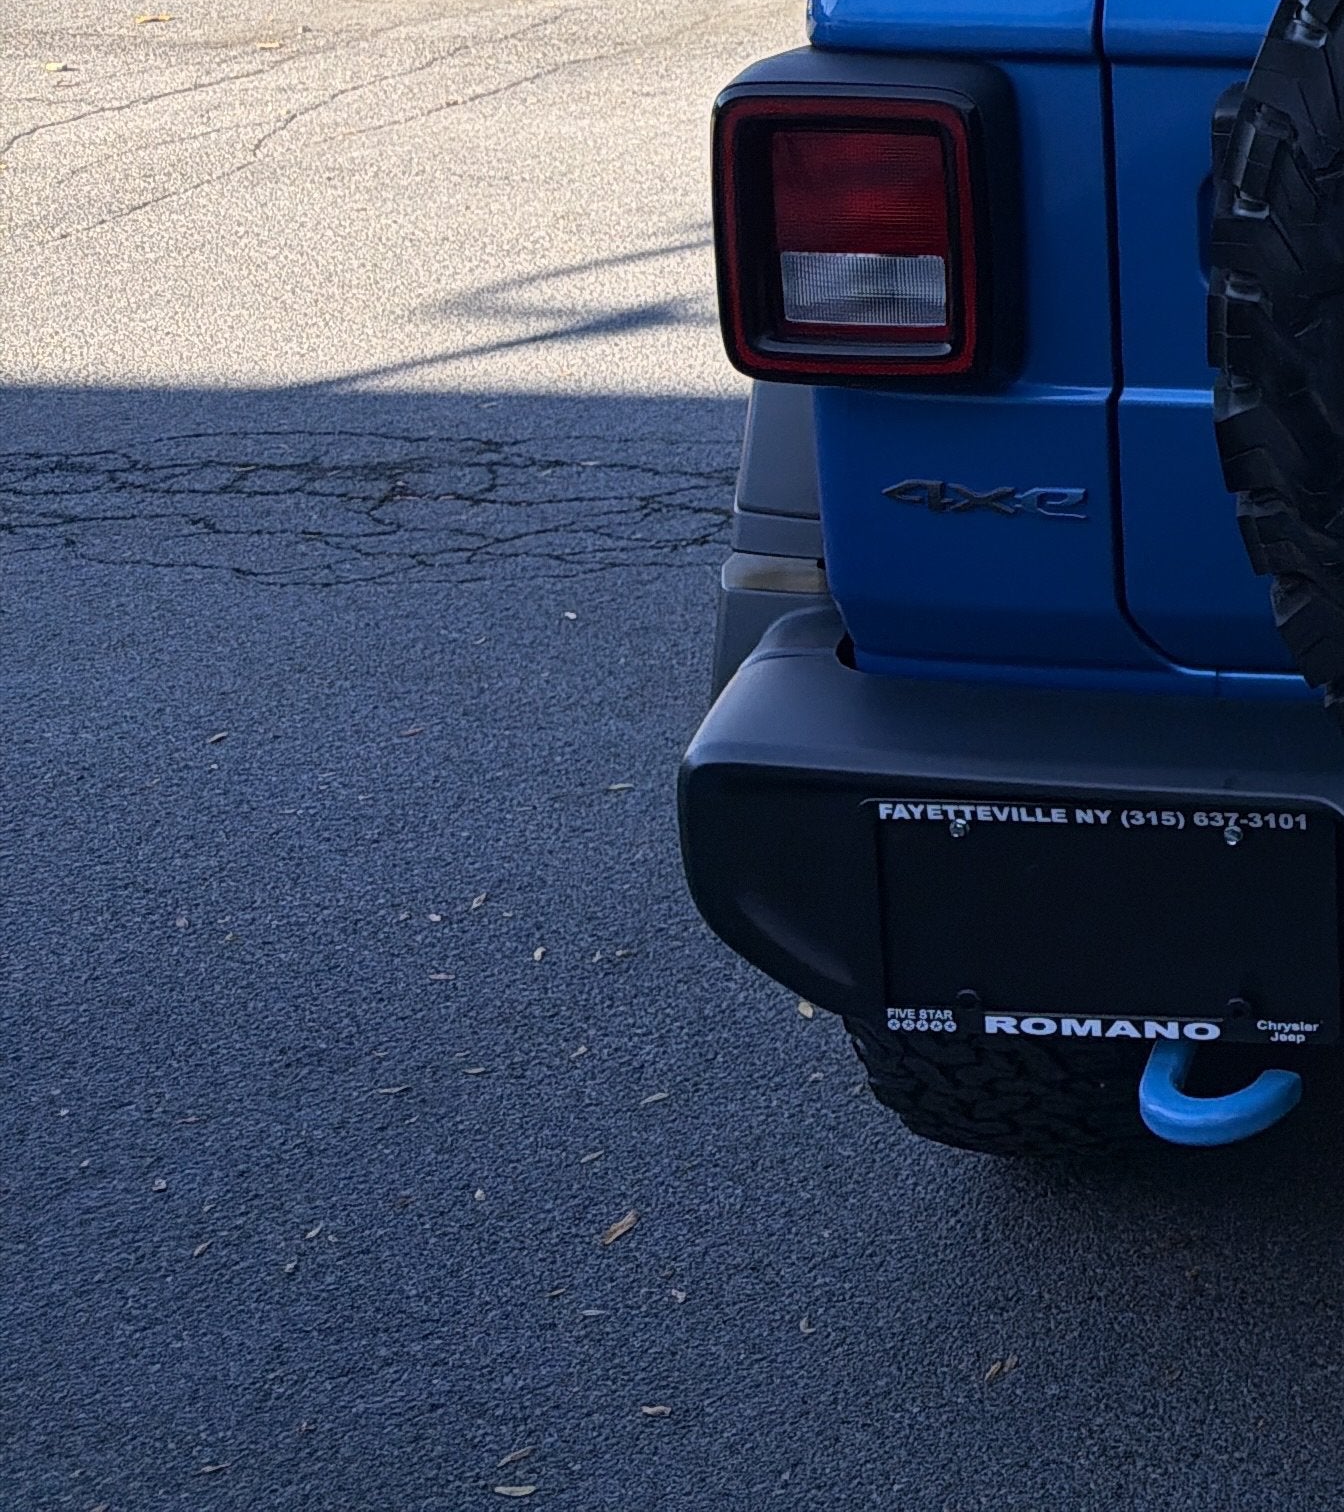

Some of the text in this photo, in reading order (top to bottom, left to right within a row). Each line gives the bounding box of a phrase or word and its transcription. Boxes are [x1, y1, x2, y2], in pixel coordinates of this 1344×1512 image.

[878, 803, 1307, 830] FAYETTEVILLE NY (315) 637-3101
[887, 1008, 953, 1021] FIVE STAR
[984, 1016, 1221, 1041] ROMANO
[1256, 1019, 1320, 1033] Chrysler
[1270, 1032, 1306, 1045] Jeep
